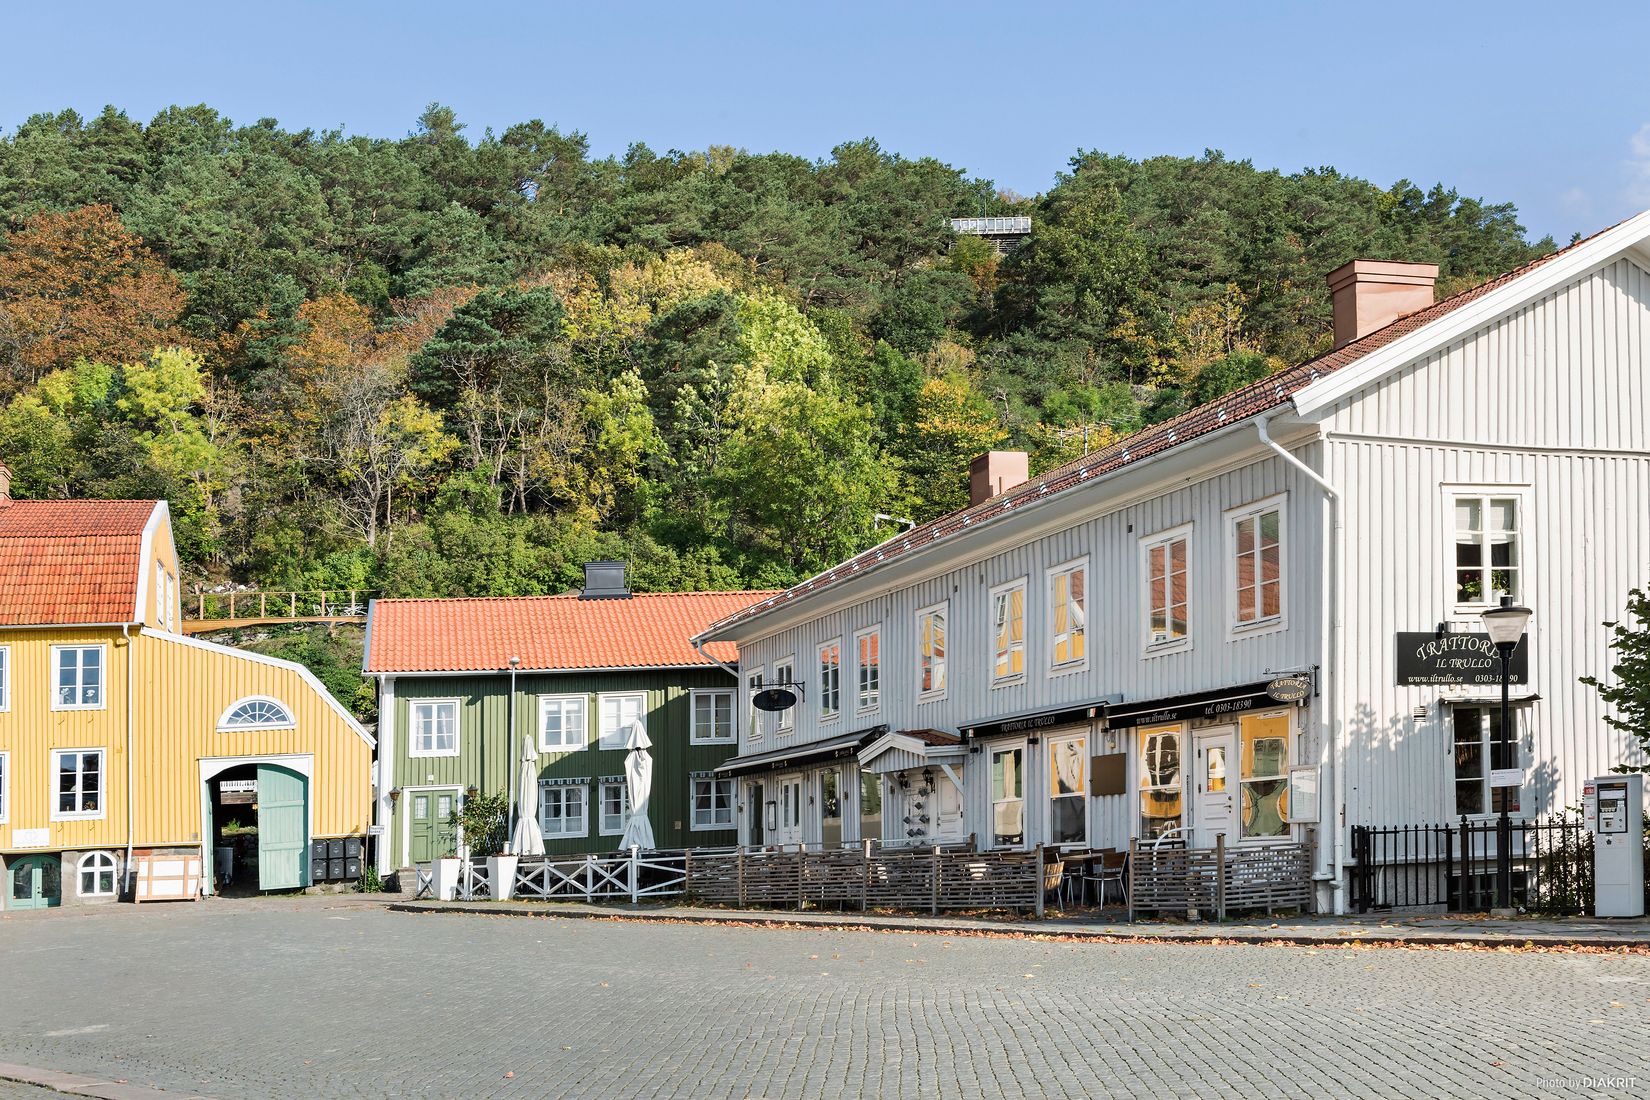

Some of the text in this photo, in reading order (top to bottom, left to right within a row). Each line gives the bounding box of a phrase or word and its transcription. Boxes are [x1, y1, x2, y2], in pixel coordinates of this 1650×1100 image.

[1416, 635, 1501, 661] TRATTORI
[1436, 657, 1492, 670] IL TRULLO
[1408, 673, 1518, 683] www.iltrullo.se 0303-1890
[1270, 679, 1307, 690] TRATTORIA
[1280, 690, 1305, 700] TRULLO
